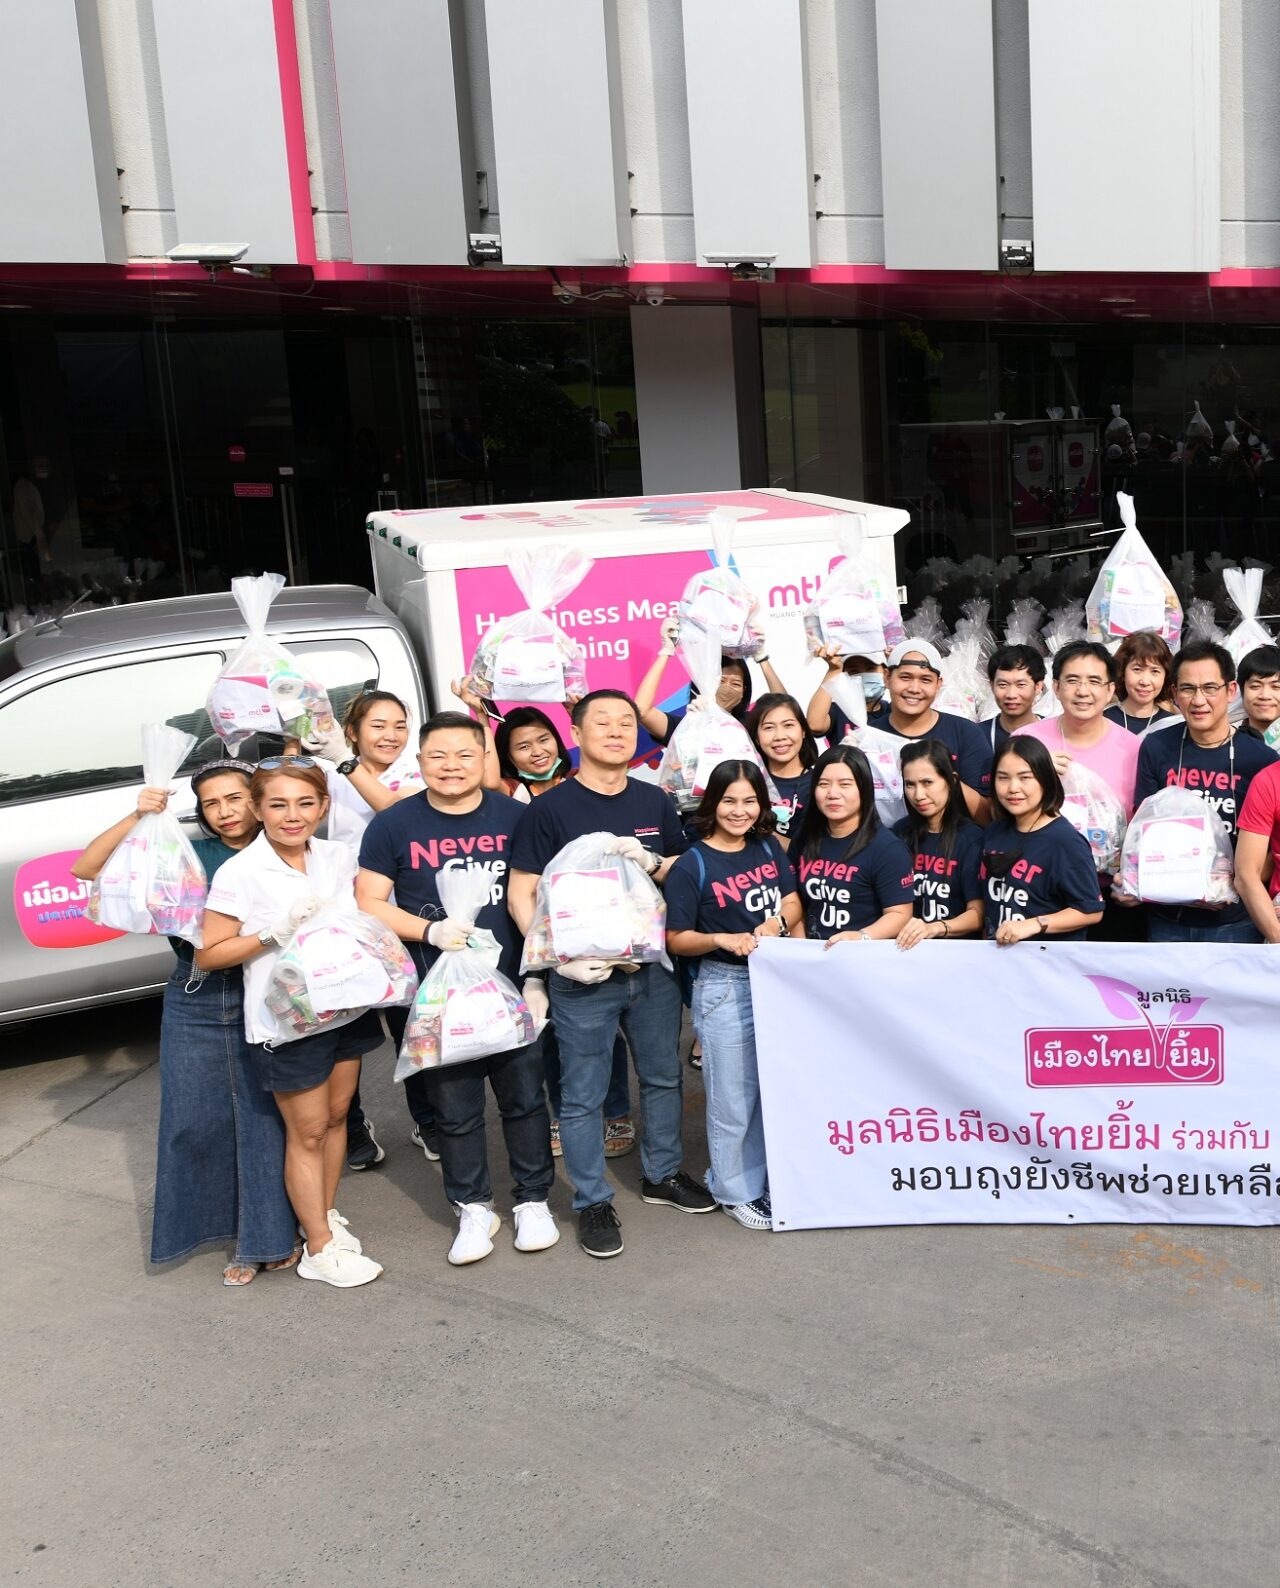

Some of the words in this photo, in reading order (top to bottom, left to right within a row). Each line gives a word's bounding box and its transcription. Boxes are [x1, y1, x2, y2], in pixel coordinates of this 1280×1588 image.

[768, 574, 821, 608] mtl
[475, 606, 620, 635] Hiness
[627, 599, 681, 622] Mea
[769, 611, 795, 619] MUANG
[1166, 767, 1241, 790] Never
[410, 833, 508, 870] Never
[914, 852, 958, 876] ever
[806, 878, 850, 903] Give
[988, 876, 1029, 907] Give
[820, 903, 851, 929] Up
[922, 899, 949, 922] Up
[1137, 988, 1192, 1008] มูลนิธิ
[1033, 1034, 1150, 1068] เมืองไทย
[1170, 1030, 1212, 1068] ยิ้ม
[827, 1100, 1160, 1155] มูลนิธิเมืองไทยยิ้ม
[1171, 1120, 1269, 1150] ร่วมกับ
